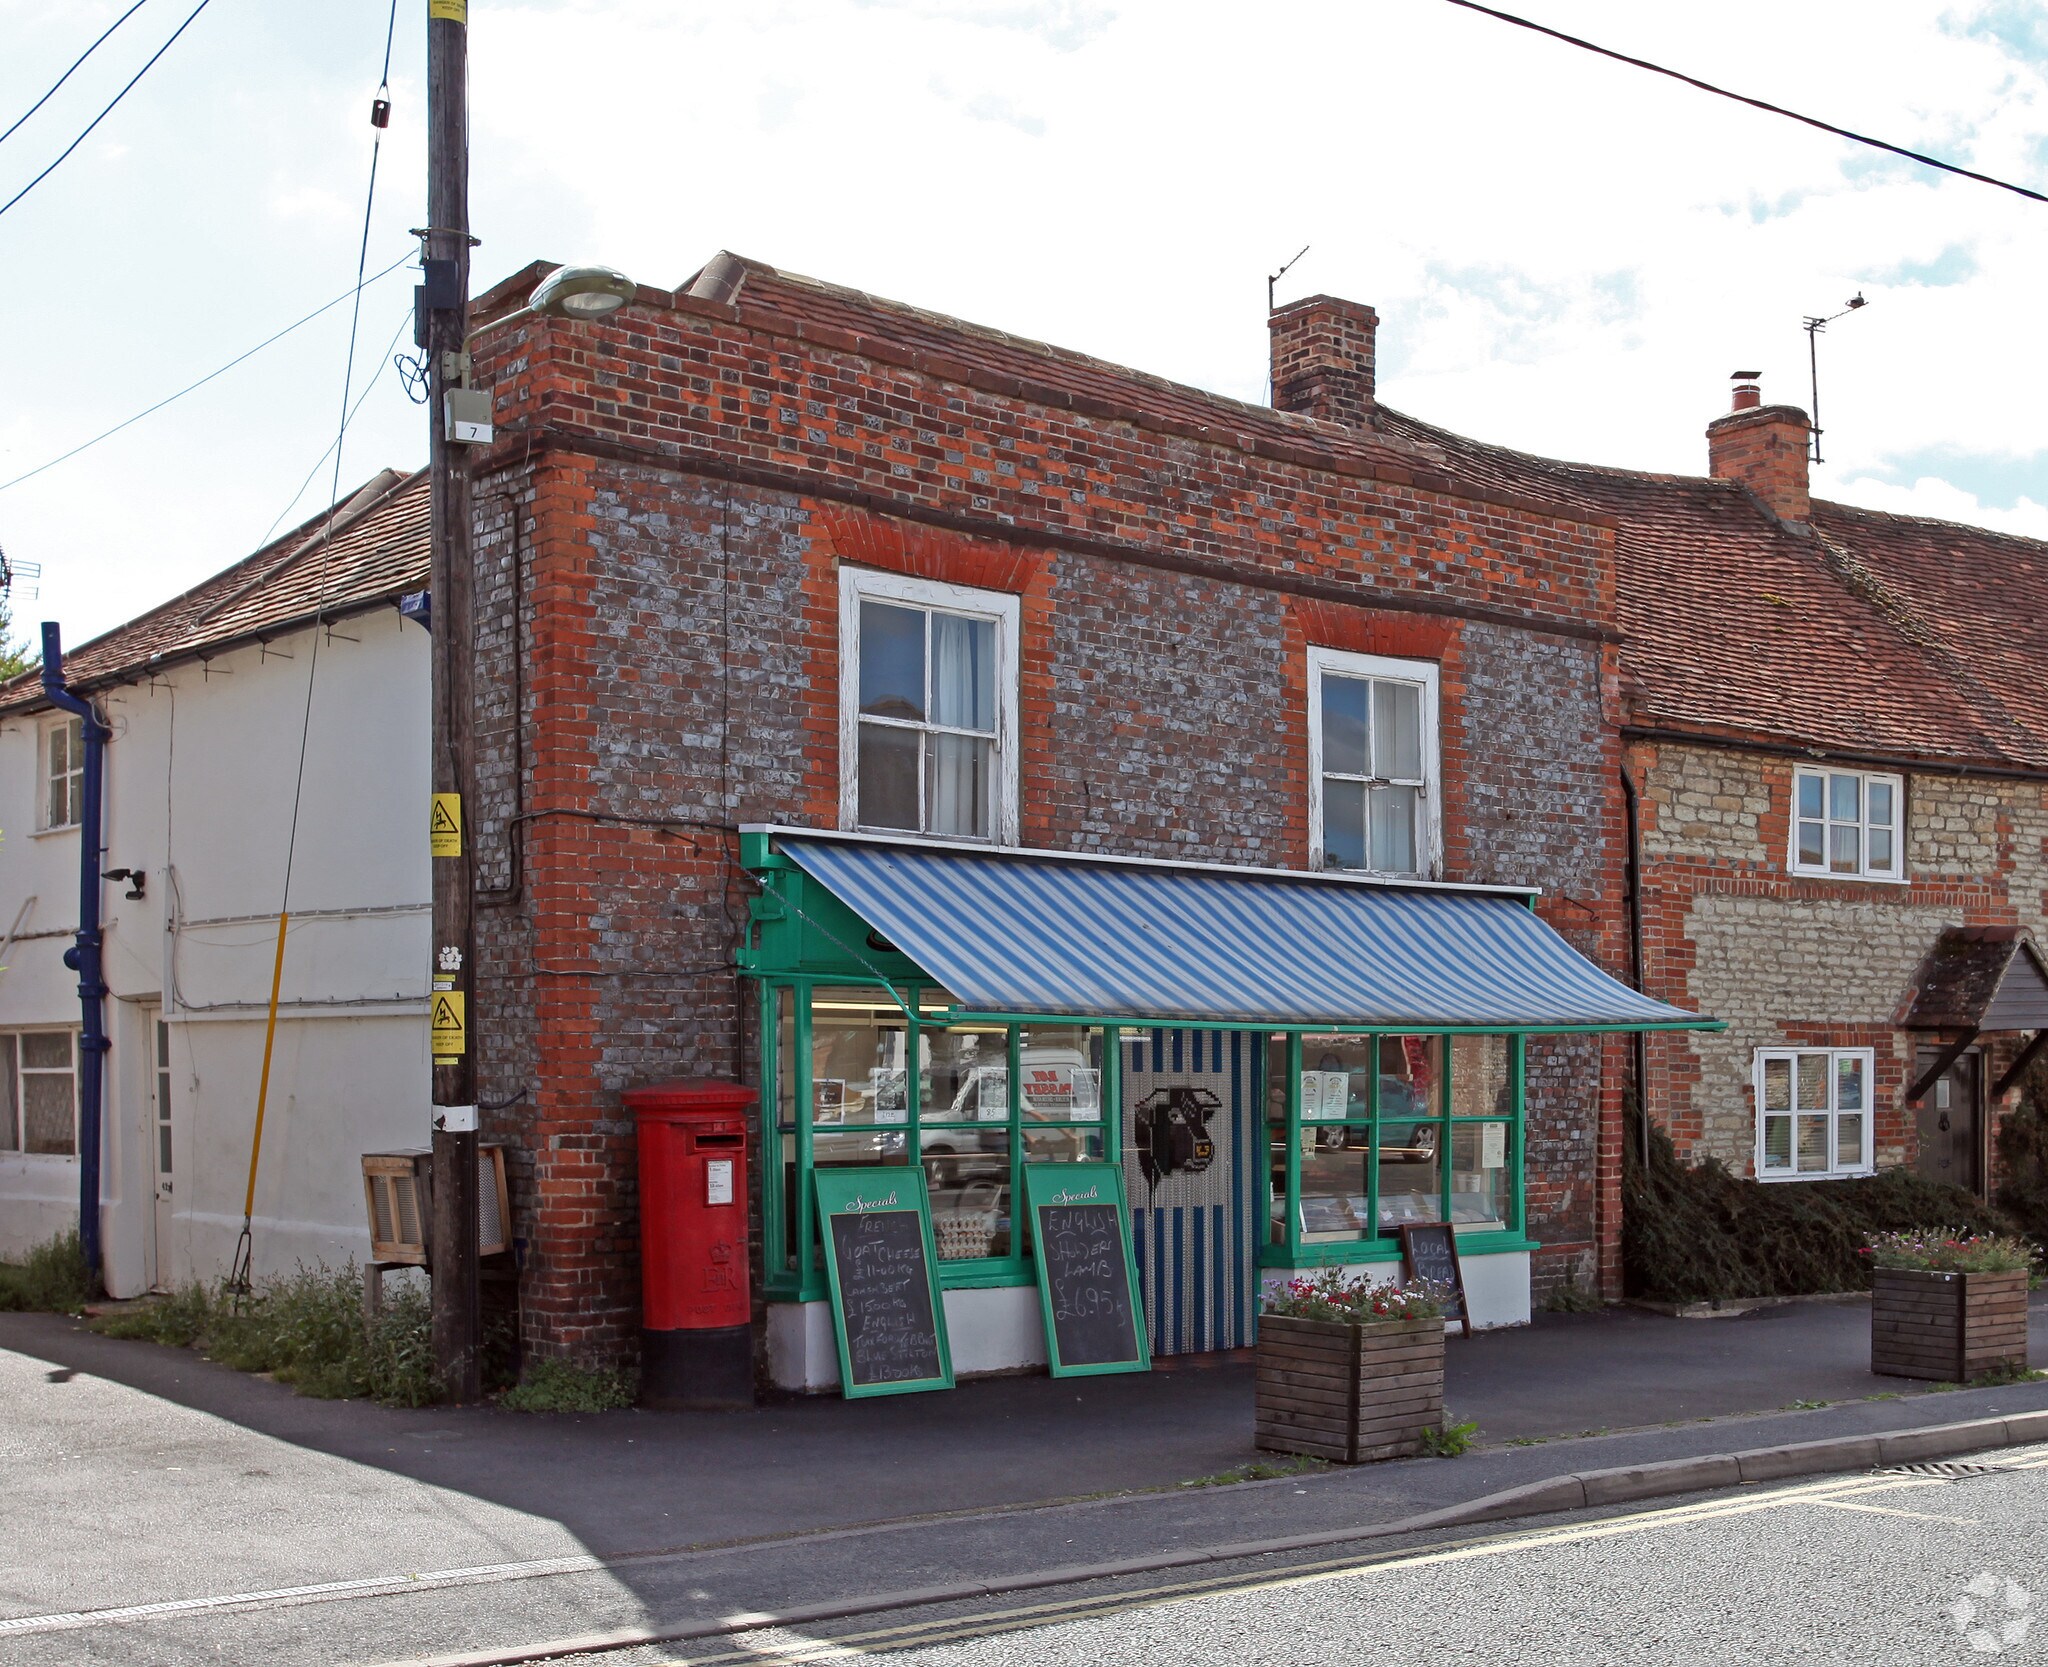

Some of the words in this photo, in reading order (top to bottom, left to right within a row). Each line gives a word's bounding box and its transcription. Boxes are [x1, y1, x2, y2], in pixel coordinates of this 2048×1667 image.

[470, 426, 478, 438] 7
[845, 1190, 898, 1214] Specials
[1052, 1185, 1098, 1206] Specials
[1049, 1210, 1118, 1232] ENGLISH
[1410, 1231, 1450, 1256] LOCAL
[1065, 1260, 1113, 1278] LAMB
